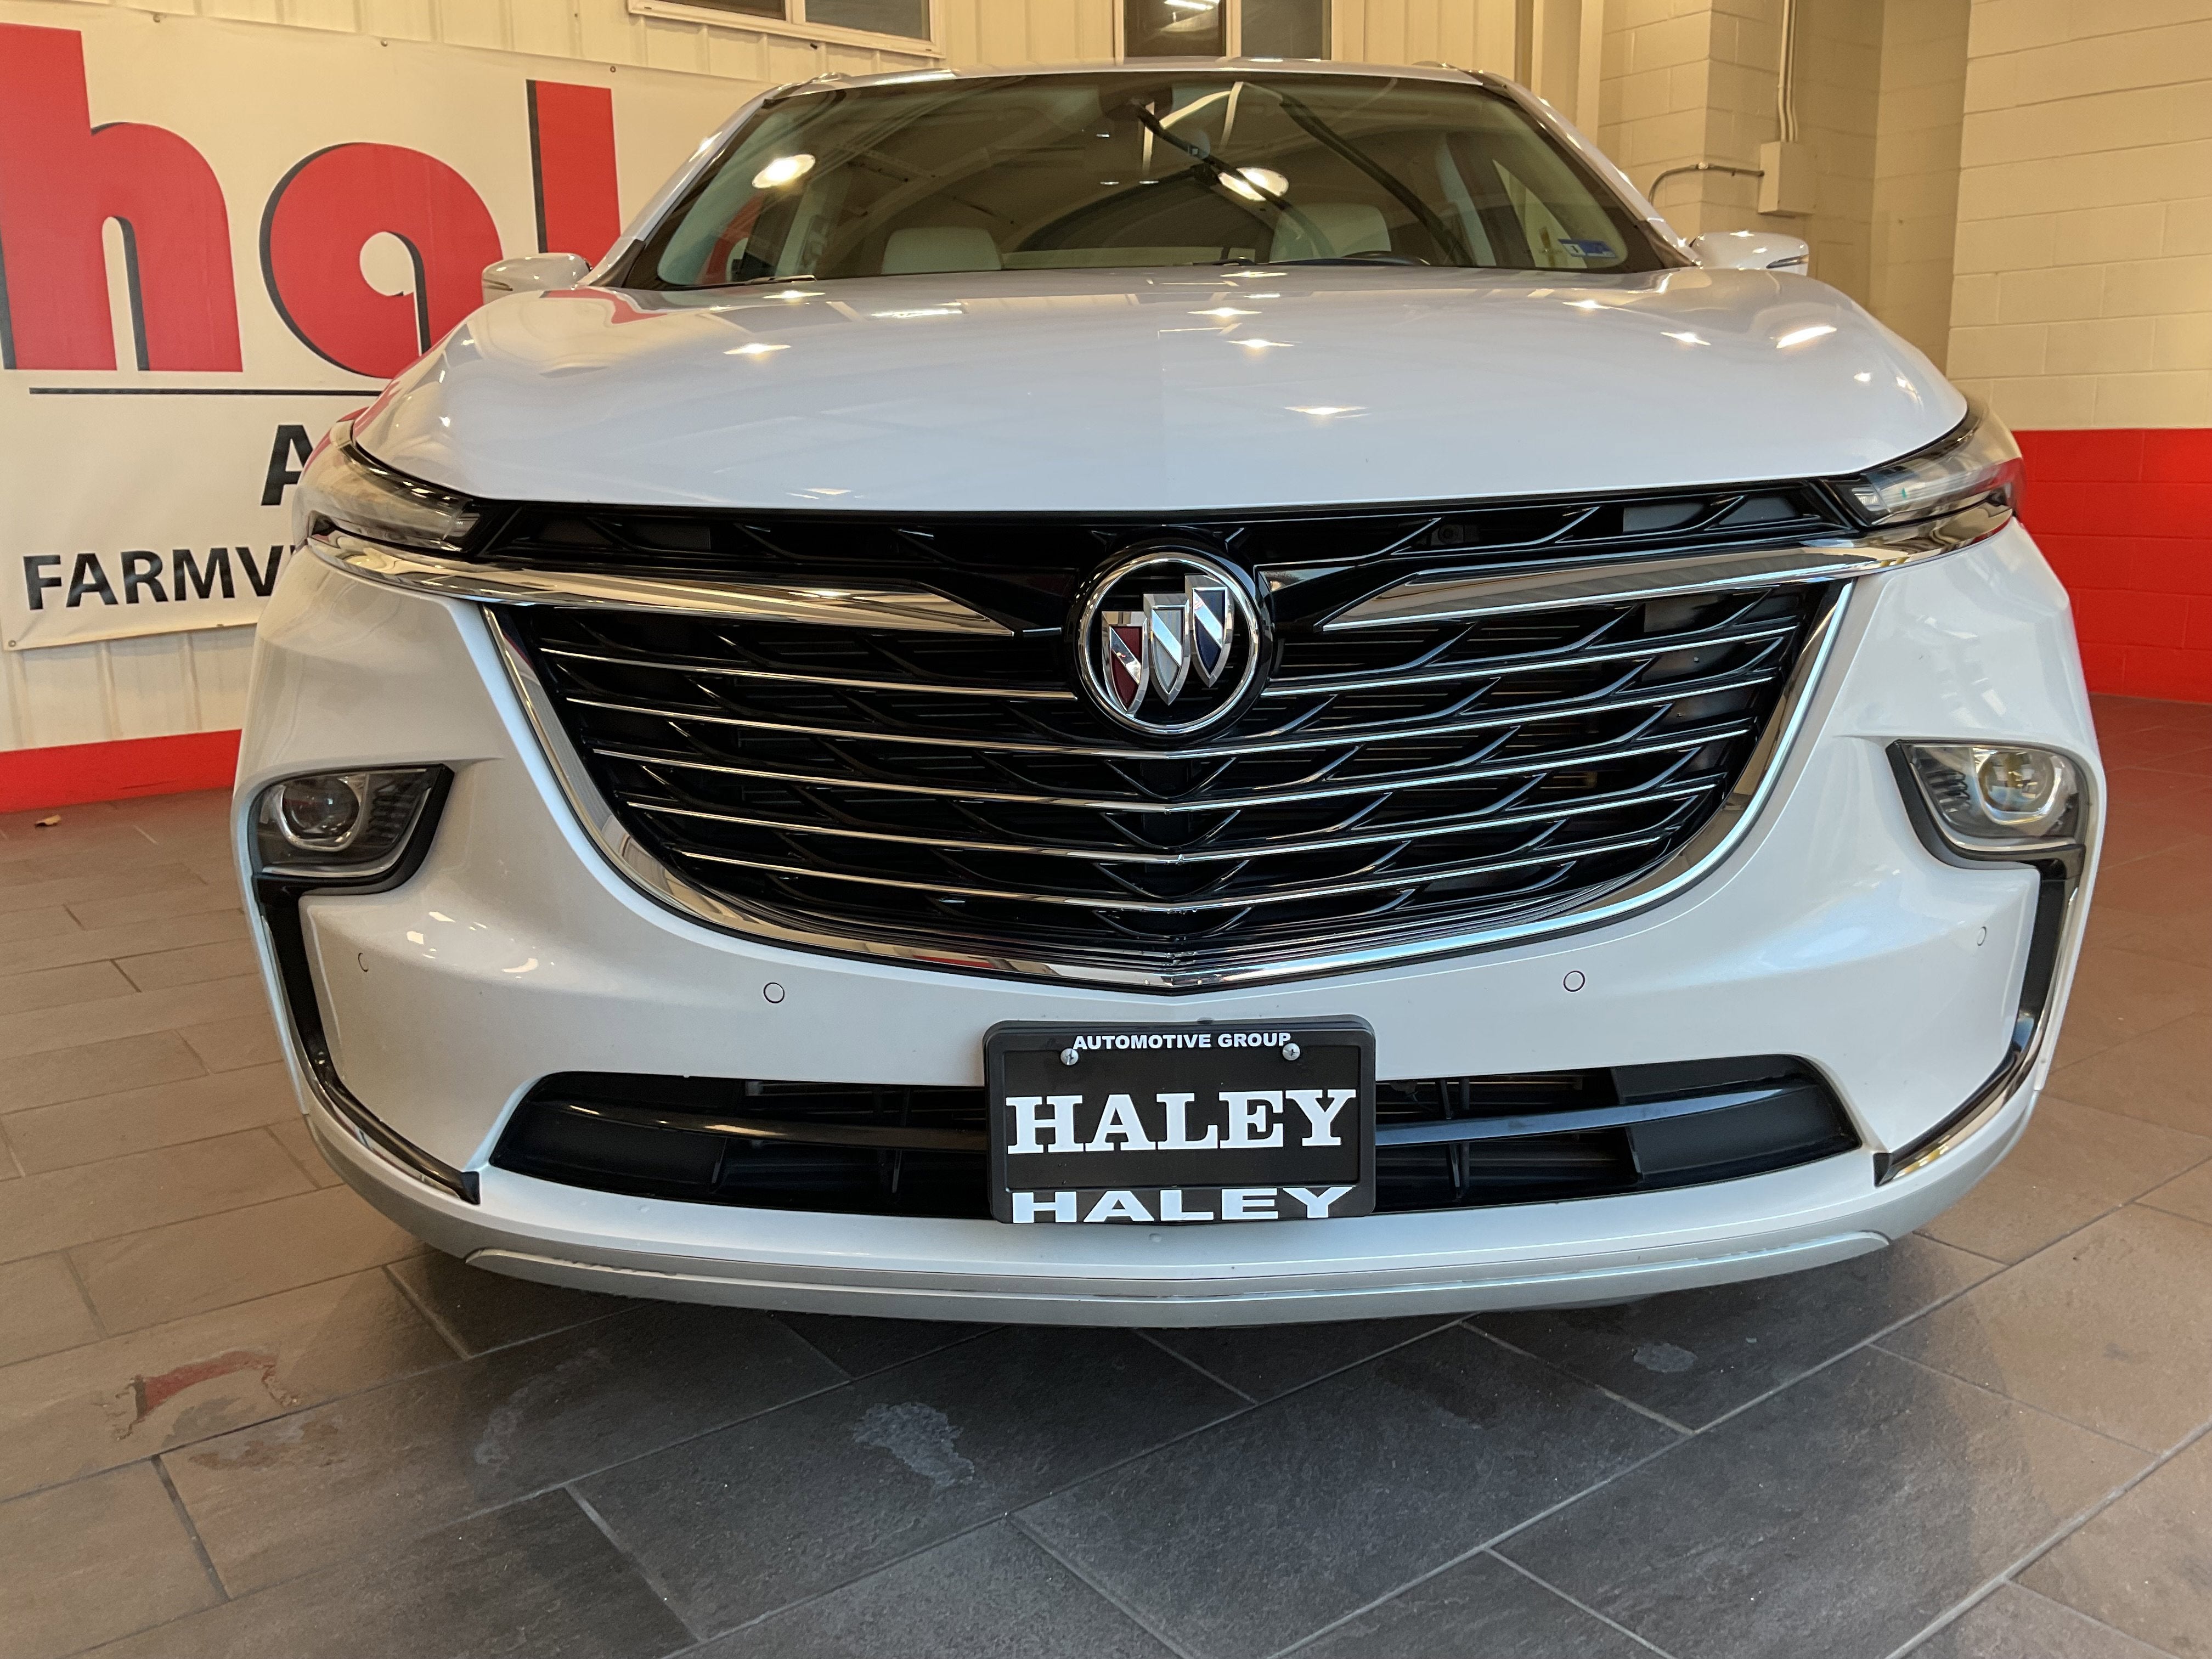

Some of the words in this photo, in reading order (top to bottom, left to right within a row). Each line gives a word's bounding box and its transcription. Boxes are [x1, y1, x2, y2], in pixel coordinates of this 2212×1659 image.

[23, 545, 296, 611] FARMV
[1073, 1035, 1211, 1050] AUTOMOTIVE
[1217, 1032, 1291, 1047] GROUP
[1006, 1089, 1356, 1154] HALEY
[1012, 1186, 1354, 1223] HALEY
